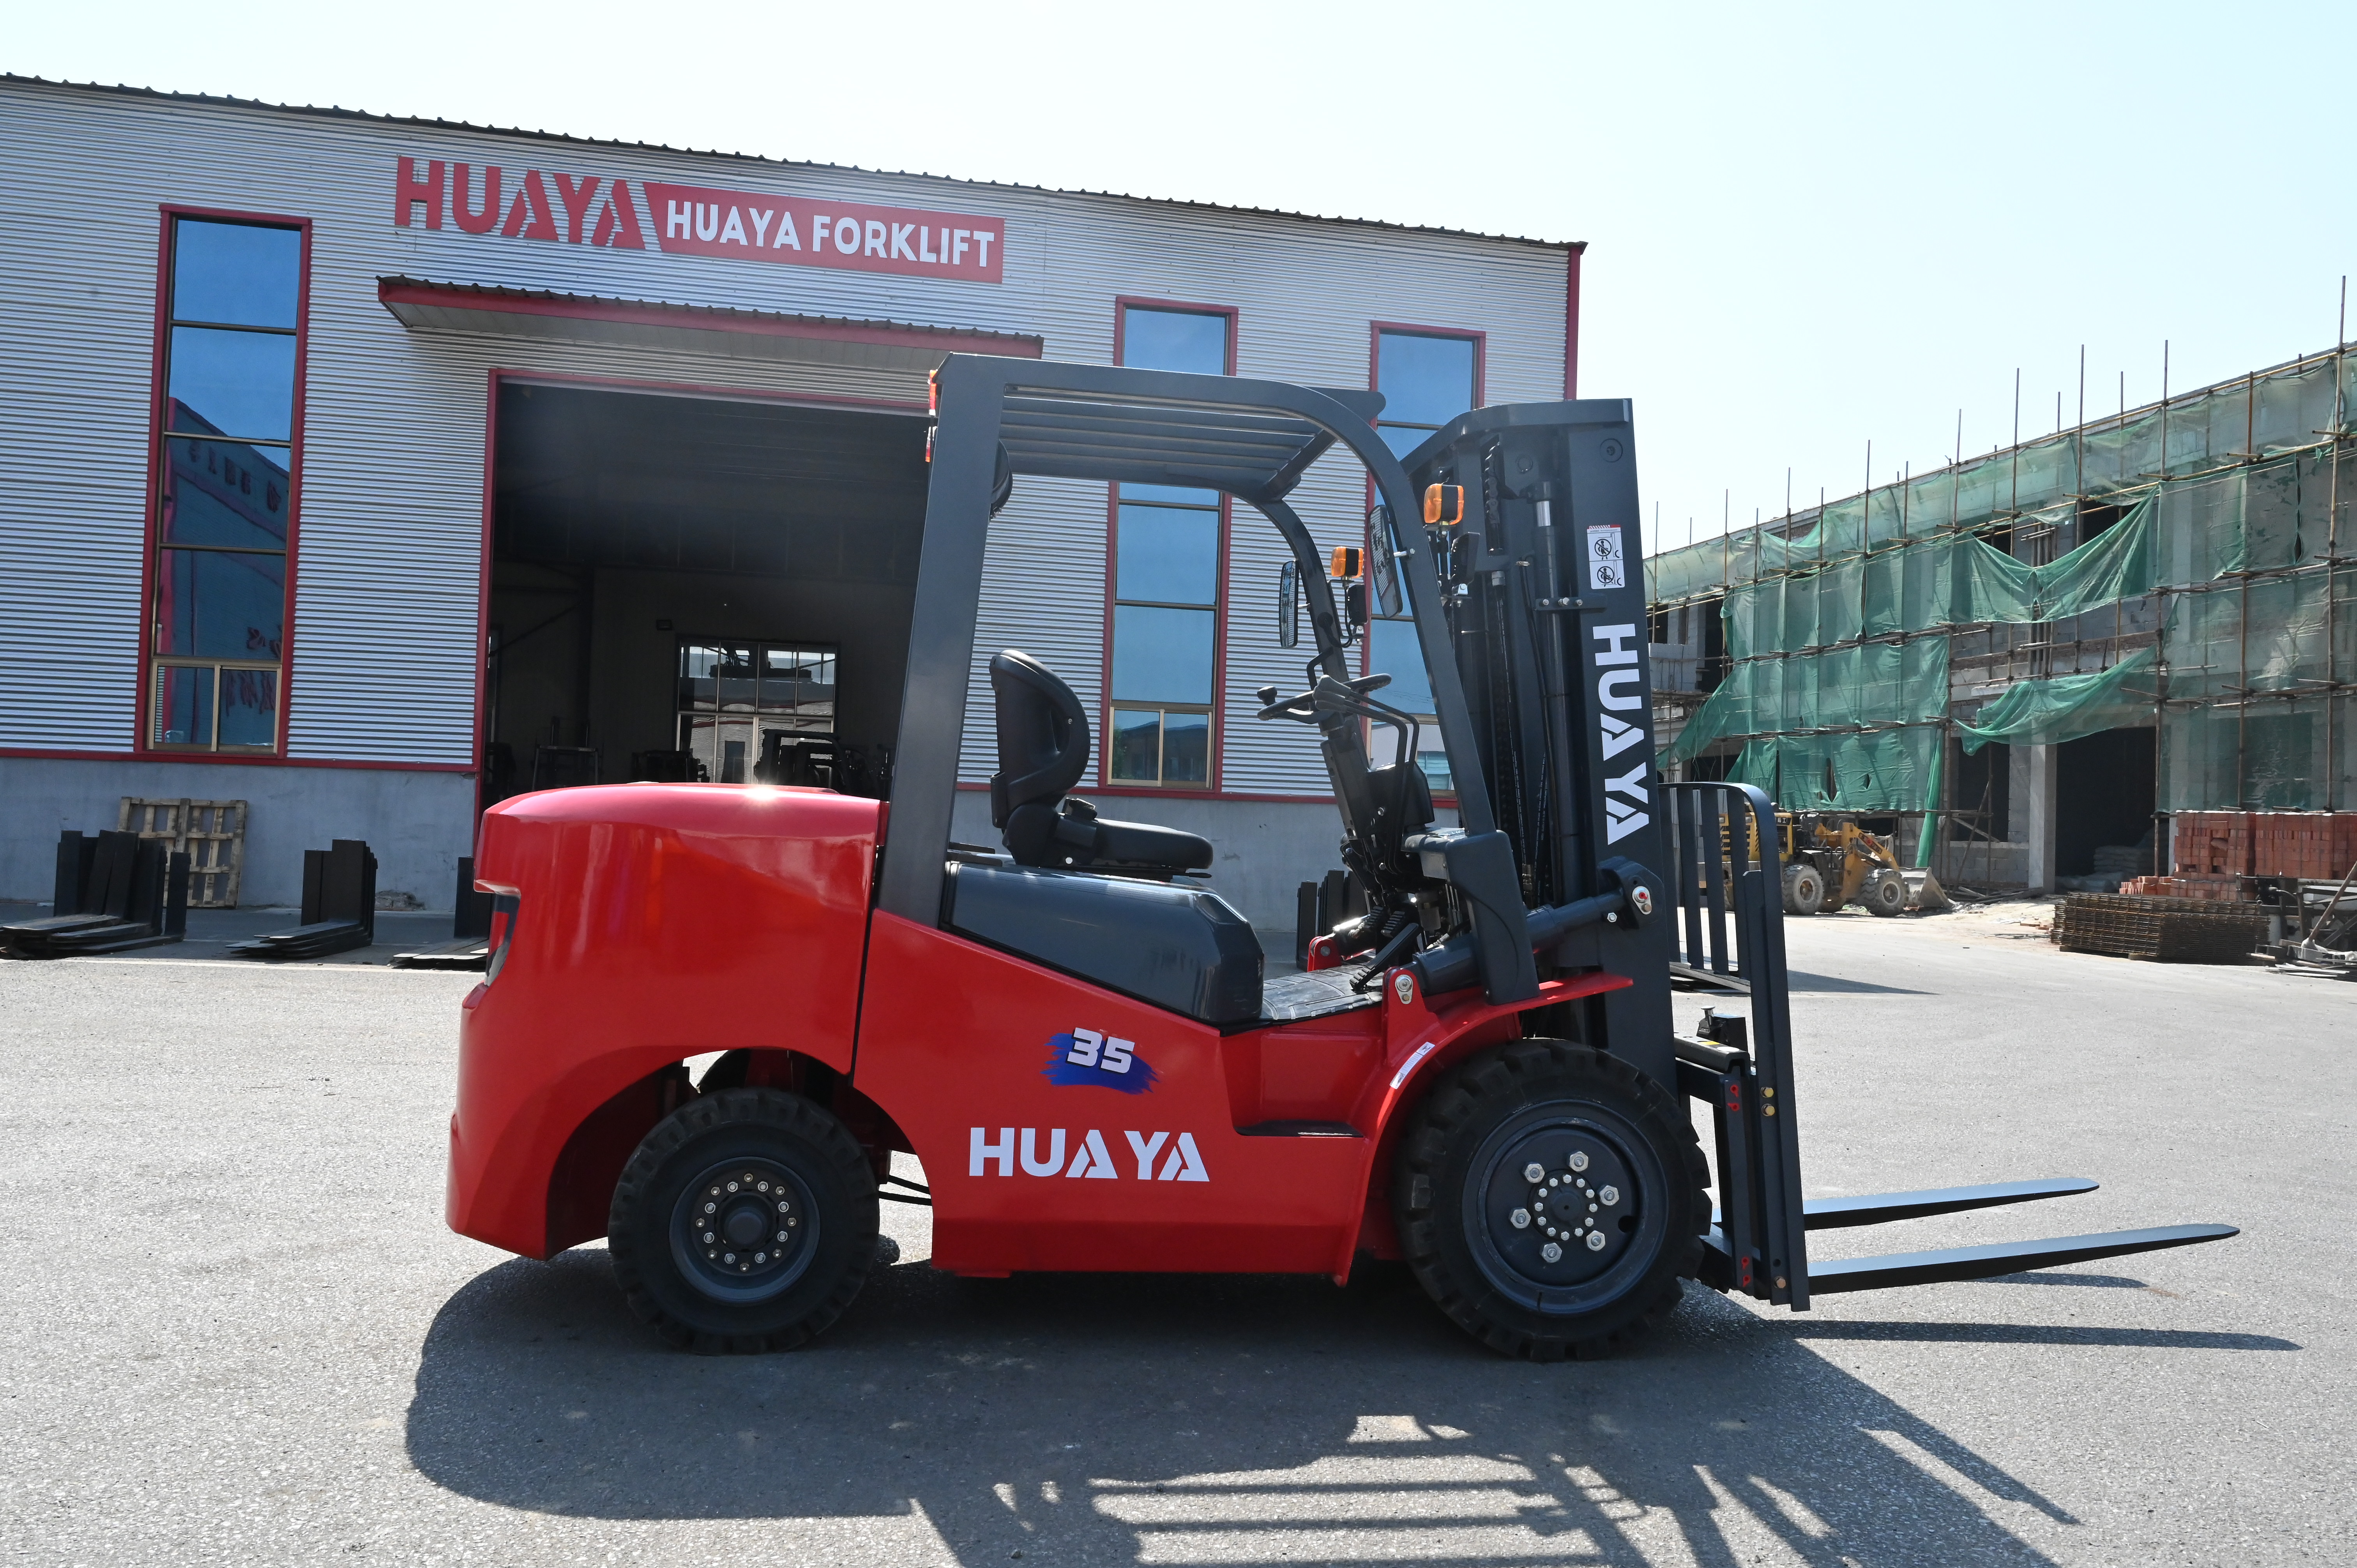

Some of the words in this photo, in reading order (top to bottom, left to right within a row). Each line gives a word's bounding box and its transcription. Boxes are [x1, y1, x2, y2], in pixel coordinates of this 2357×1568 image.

[396, 157, 645, 250] HUAYA
[666, 200, 802, 251] HUAYA
[813, 214, 995, 268] FORKLIFT
[1592, 623, 1649, 846] HUAYA
[1066, 1027, 1135, 1074] 35
